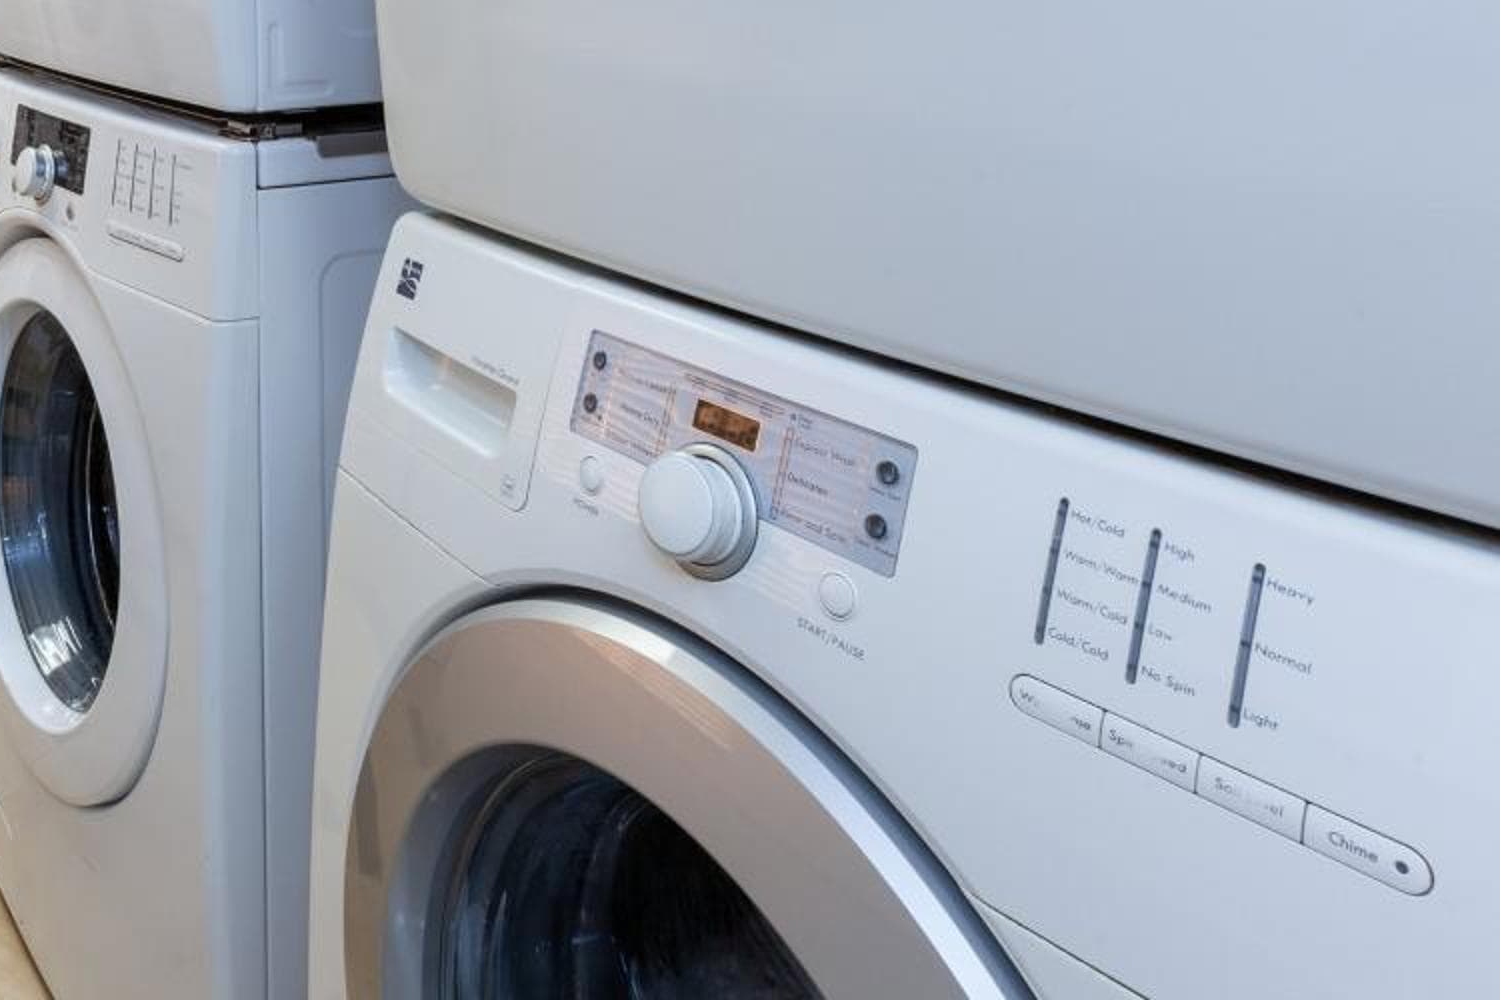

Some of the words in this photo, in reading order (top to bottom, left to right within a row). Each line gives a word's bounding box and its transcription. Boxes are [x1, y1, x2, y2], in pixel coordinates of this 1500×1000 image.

[1071, 510, 1125, 538] Hot/Cold
[1164, 542, 1195, 563] High
[1057, 588, 1128, 625] Warm/Cold
[1157, 584, 1212, 613] Medium
[1266, 577, 1315, 606] Heavy
[1048, 627, 1109, 660] Cold/Cold
[1255, 642, 1313, 675] Normal
[1141, 665, 1161, 682] No
[1167, 675, 1196, 697] Spin
[1244, 706, 1279, 731] Light
[1328, 831, 1379, 863] Chime
